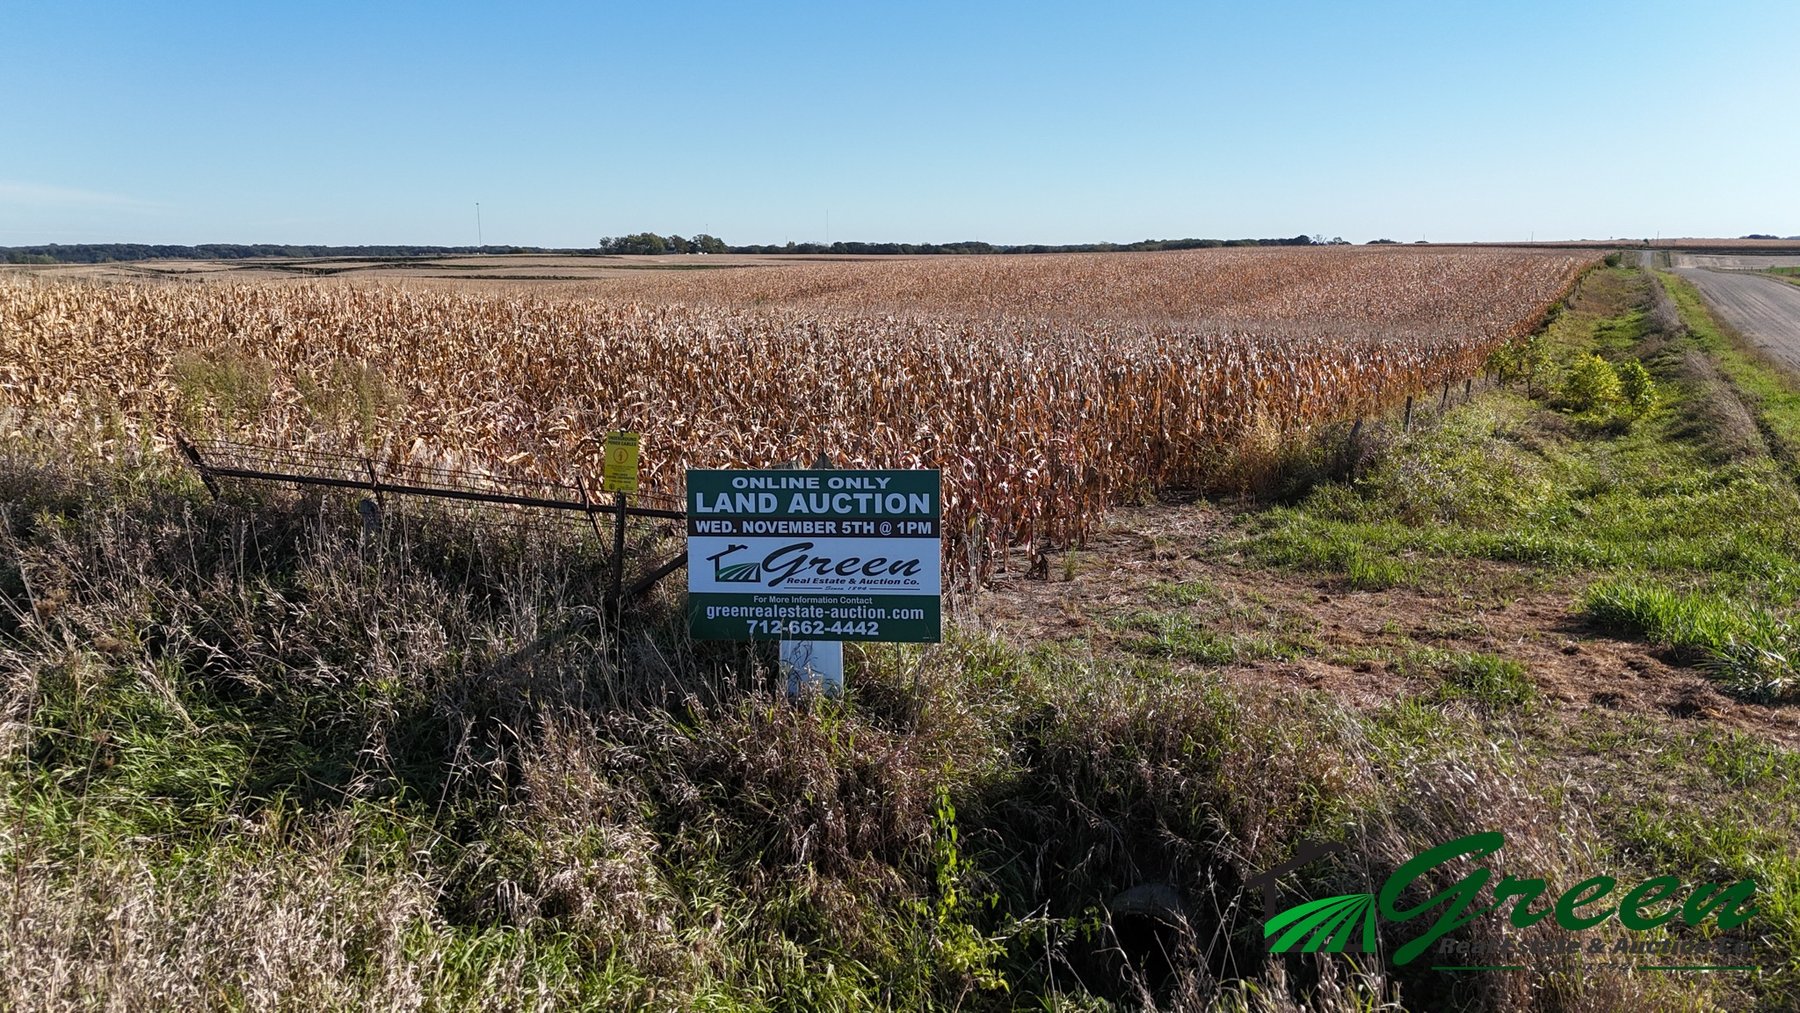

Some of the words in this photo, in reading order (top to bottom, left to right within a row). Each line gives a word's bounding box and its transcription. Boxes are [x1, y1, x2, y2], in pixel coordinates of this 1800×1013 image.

[731, 476, 820, 489] ONLINE
[827, 476, 892, 489] ONLY
[695, 492, 778, 514] LAND
[787, 493, 931, 514] AUCTION
[695, 520, 738, 533] WED.
[742, 520, 837, 534] NOVEMBER
[841, 521, 875, 534] 5TH
[879, 521, 893, 536] @
[896, 521, 932, 535] 1PM
[762, 542, 922, 587] Green
[786, 577, 811, 585] Real
[812, 577, 847, 585] Estate
[848, 577, 857, 585] &
[858, 578, 902, 586] Auction
[903, 578, 920, 586] Co.
[753, 595, 767, 603] For
[769, 595, 790, 604] More
[791, 596, 838, 604] Information
[839, 597, 873, 605] Contact
[706, 604, 925, 620] greenrealestate-auction.com
[746, 619, 880, 637] 712-662-4442
